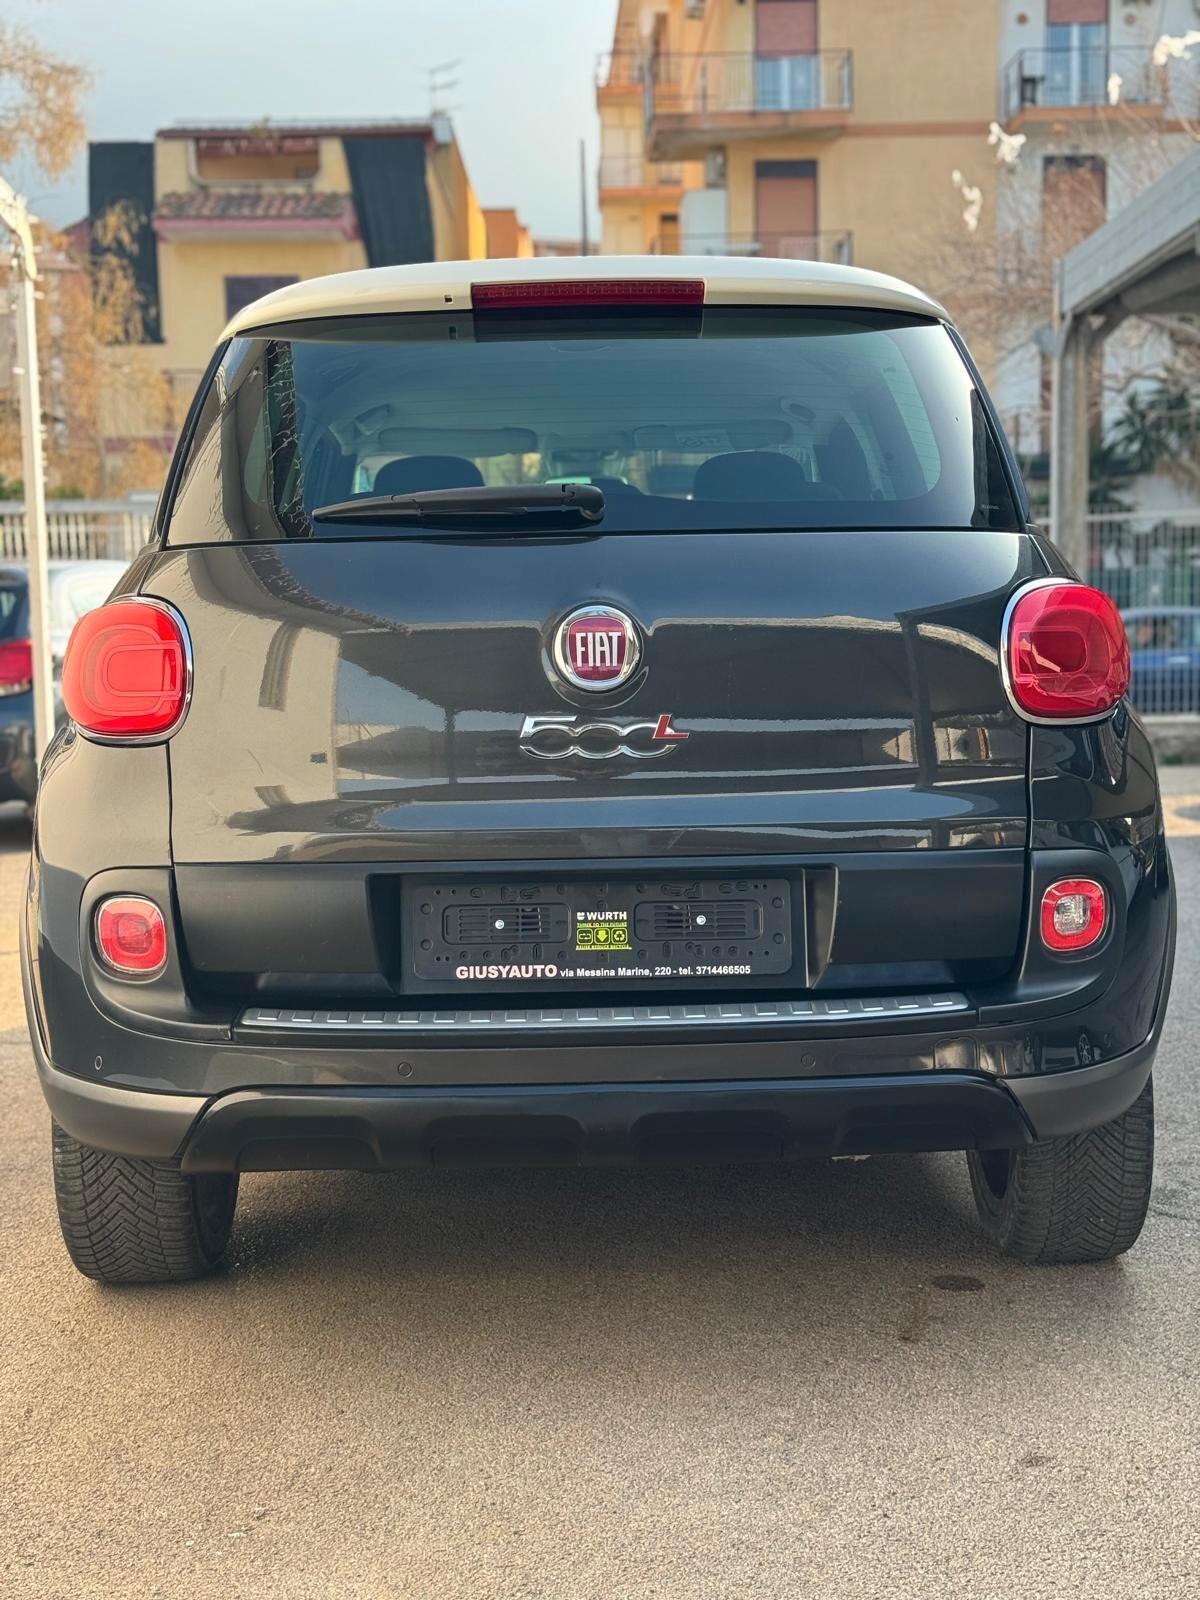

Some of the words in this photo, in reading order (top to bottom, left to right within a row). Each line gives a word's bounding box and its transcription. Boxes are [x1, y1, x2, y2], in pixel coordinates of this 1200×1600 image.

[575, 632, 621, 667] FIAT
[586, 911, 627, 920] WURTH
[455, 964, 558, 979] GIUSYAUTO
[560, 968, 574, 977] via
[576, 967, 615, 977] Messina
[617, 966, 652, 977] Marine,
[654, 966, 671, 976] 220
[678, 966, 694, 975] tel.
[695, 965, 751, 975] 3714466505
